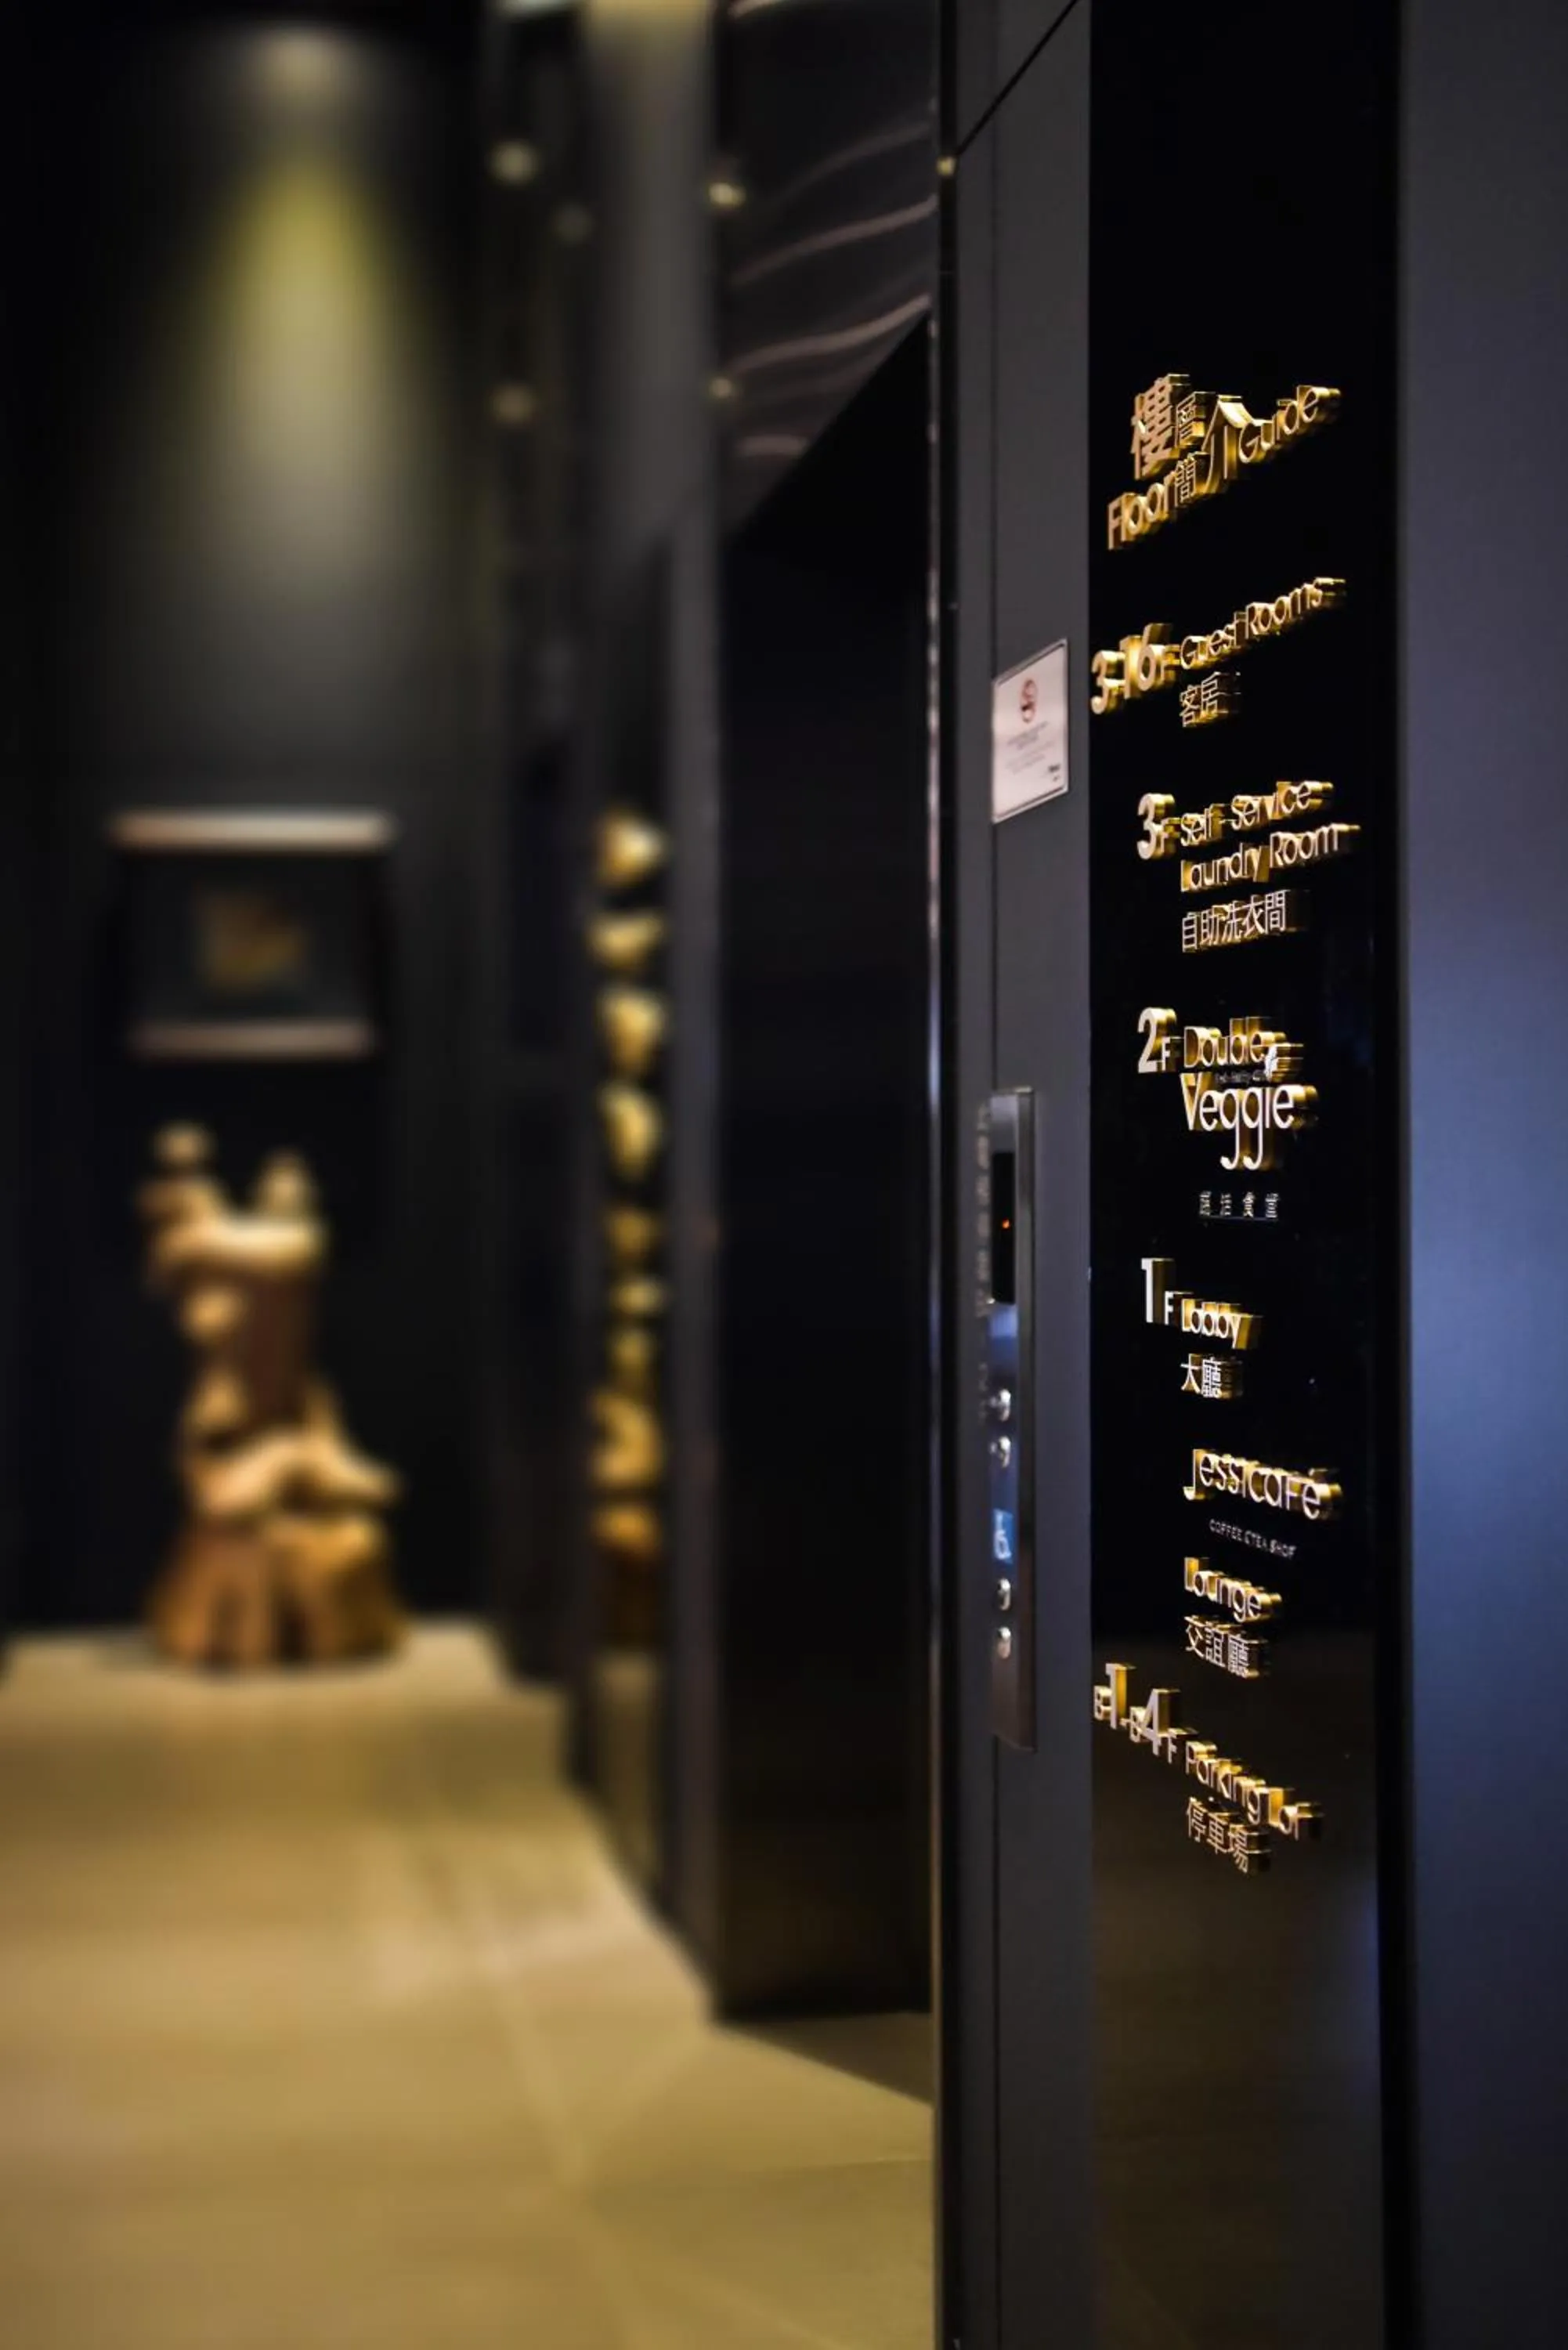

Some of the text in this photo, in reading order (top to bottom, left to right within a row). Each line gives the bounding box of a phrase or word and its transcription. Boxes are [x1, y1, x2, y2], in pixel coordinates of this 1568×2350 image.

[1107, 385, 1325, 550] Floor Guide
[1180, 612, 1246, 669] Guest
[1245, 578, 1328, 640] Rooms
[1180, 671, 1222, 728] 客房
[1136, 793, 1174, 860] 3F
[1180, 824, 1343, 893] Laundry Room
[1181, 889, 1287, 953] 自助洗衣間
[1137, 1007, 1269, 1074] 2F Double
[1180, 1072, 1300, 1170] Veggie
[1140, 1257, 1245, 1350] 1F Lobby
[1180, 1353, 1223, 1399] 大廳
[1209, 1517, 1243, 1542] COFFEE
[1183, 1556, 1265, 1622] Lounge
[1183, 1614, 1252, 1678] 交誼廳
[1185, 1741, 1265, 1825] Parking
[1268, 1788, 1308, 1841] Lot
[1186, 1796, 1250, 1873] 停車場
